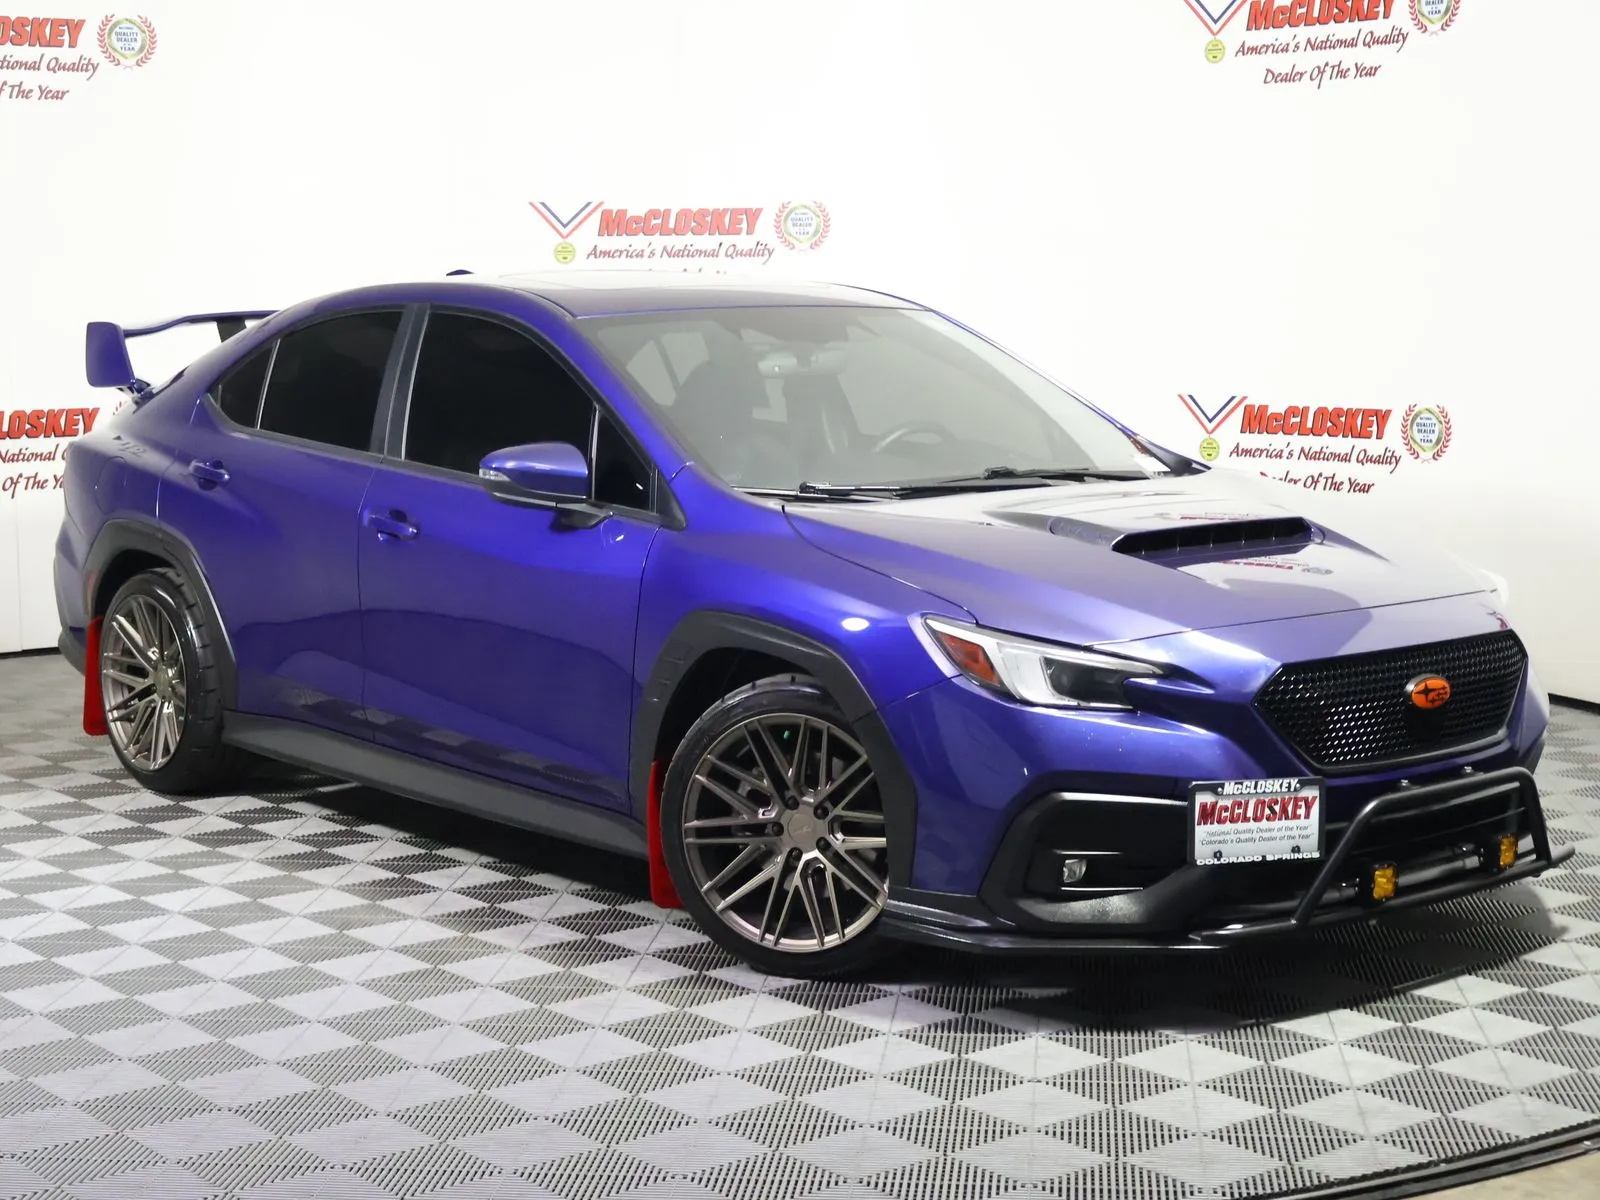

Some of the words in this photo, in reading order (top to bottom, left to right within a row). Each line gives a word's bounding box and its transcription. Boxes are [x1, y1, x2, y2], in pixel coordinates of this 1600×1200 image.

[1235, 34, 1300, 57] America's
[1304, 28, 1361, 52] National
[1362, 25, 1409, 53] Quality
[46, 54, 100, 81] Quality
[1263, 64, 1307, 85] Dealer
[1309, 61, 1329, 89] Of
[1329, 60, 1350, 80] The
[1354, 61, 1382, 79] Year
[8, 80, 34, 100] The
[38, 84, 70, 101] Year
[598, 207, 763, 237] McCLOSKEY
[586, 242, 655, 260] America's
[660, 241, 722, 259] National
[724, 240, 775, 265] Quality
[1240, 404, 1392, 440] McCLOSKEY
[1229, 442, 1294, 460] America's
[1298, 445, 1355, 464] National
[1356, 447, 1402, 474] Quality
[2, 472, 23, 499] Of
[24, 471, 49, 491] The
[1303, 472, 1323, 491] Of
[1323, 473, 1344, 492] The
[1347, 476, 1375, 494] Year
[1223, 779, 1299, 795] McCLOSKEY
[1197, 796, 1318, 826] McCLOSKEY
[1233, 827, 1255, 836] Quality
[1256, 826, 1275, 834] Dealer
[1235, 836, 1257, 845] Quality
[1258, 835, 1278, 843] Dealer
[1197, 855, 1262, 866] COLORADO
[1265, 850, 1320, 862] SPRINGS
